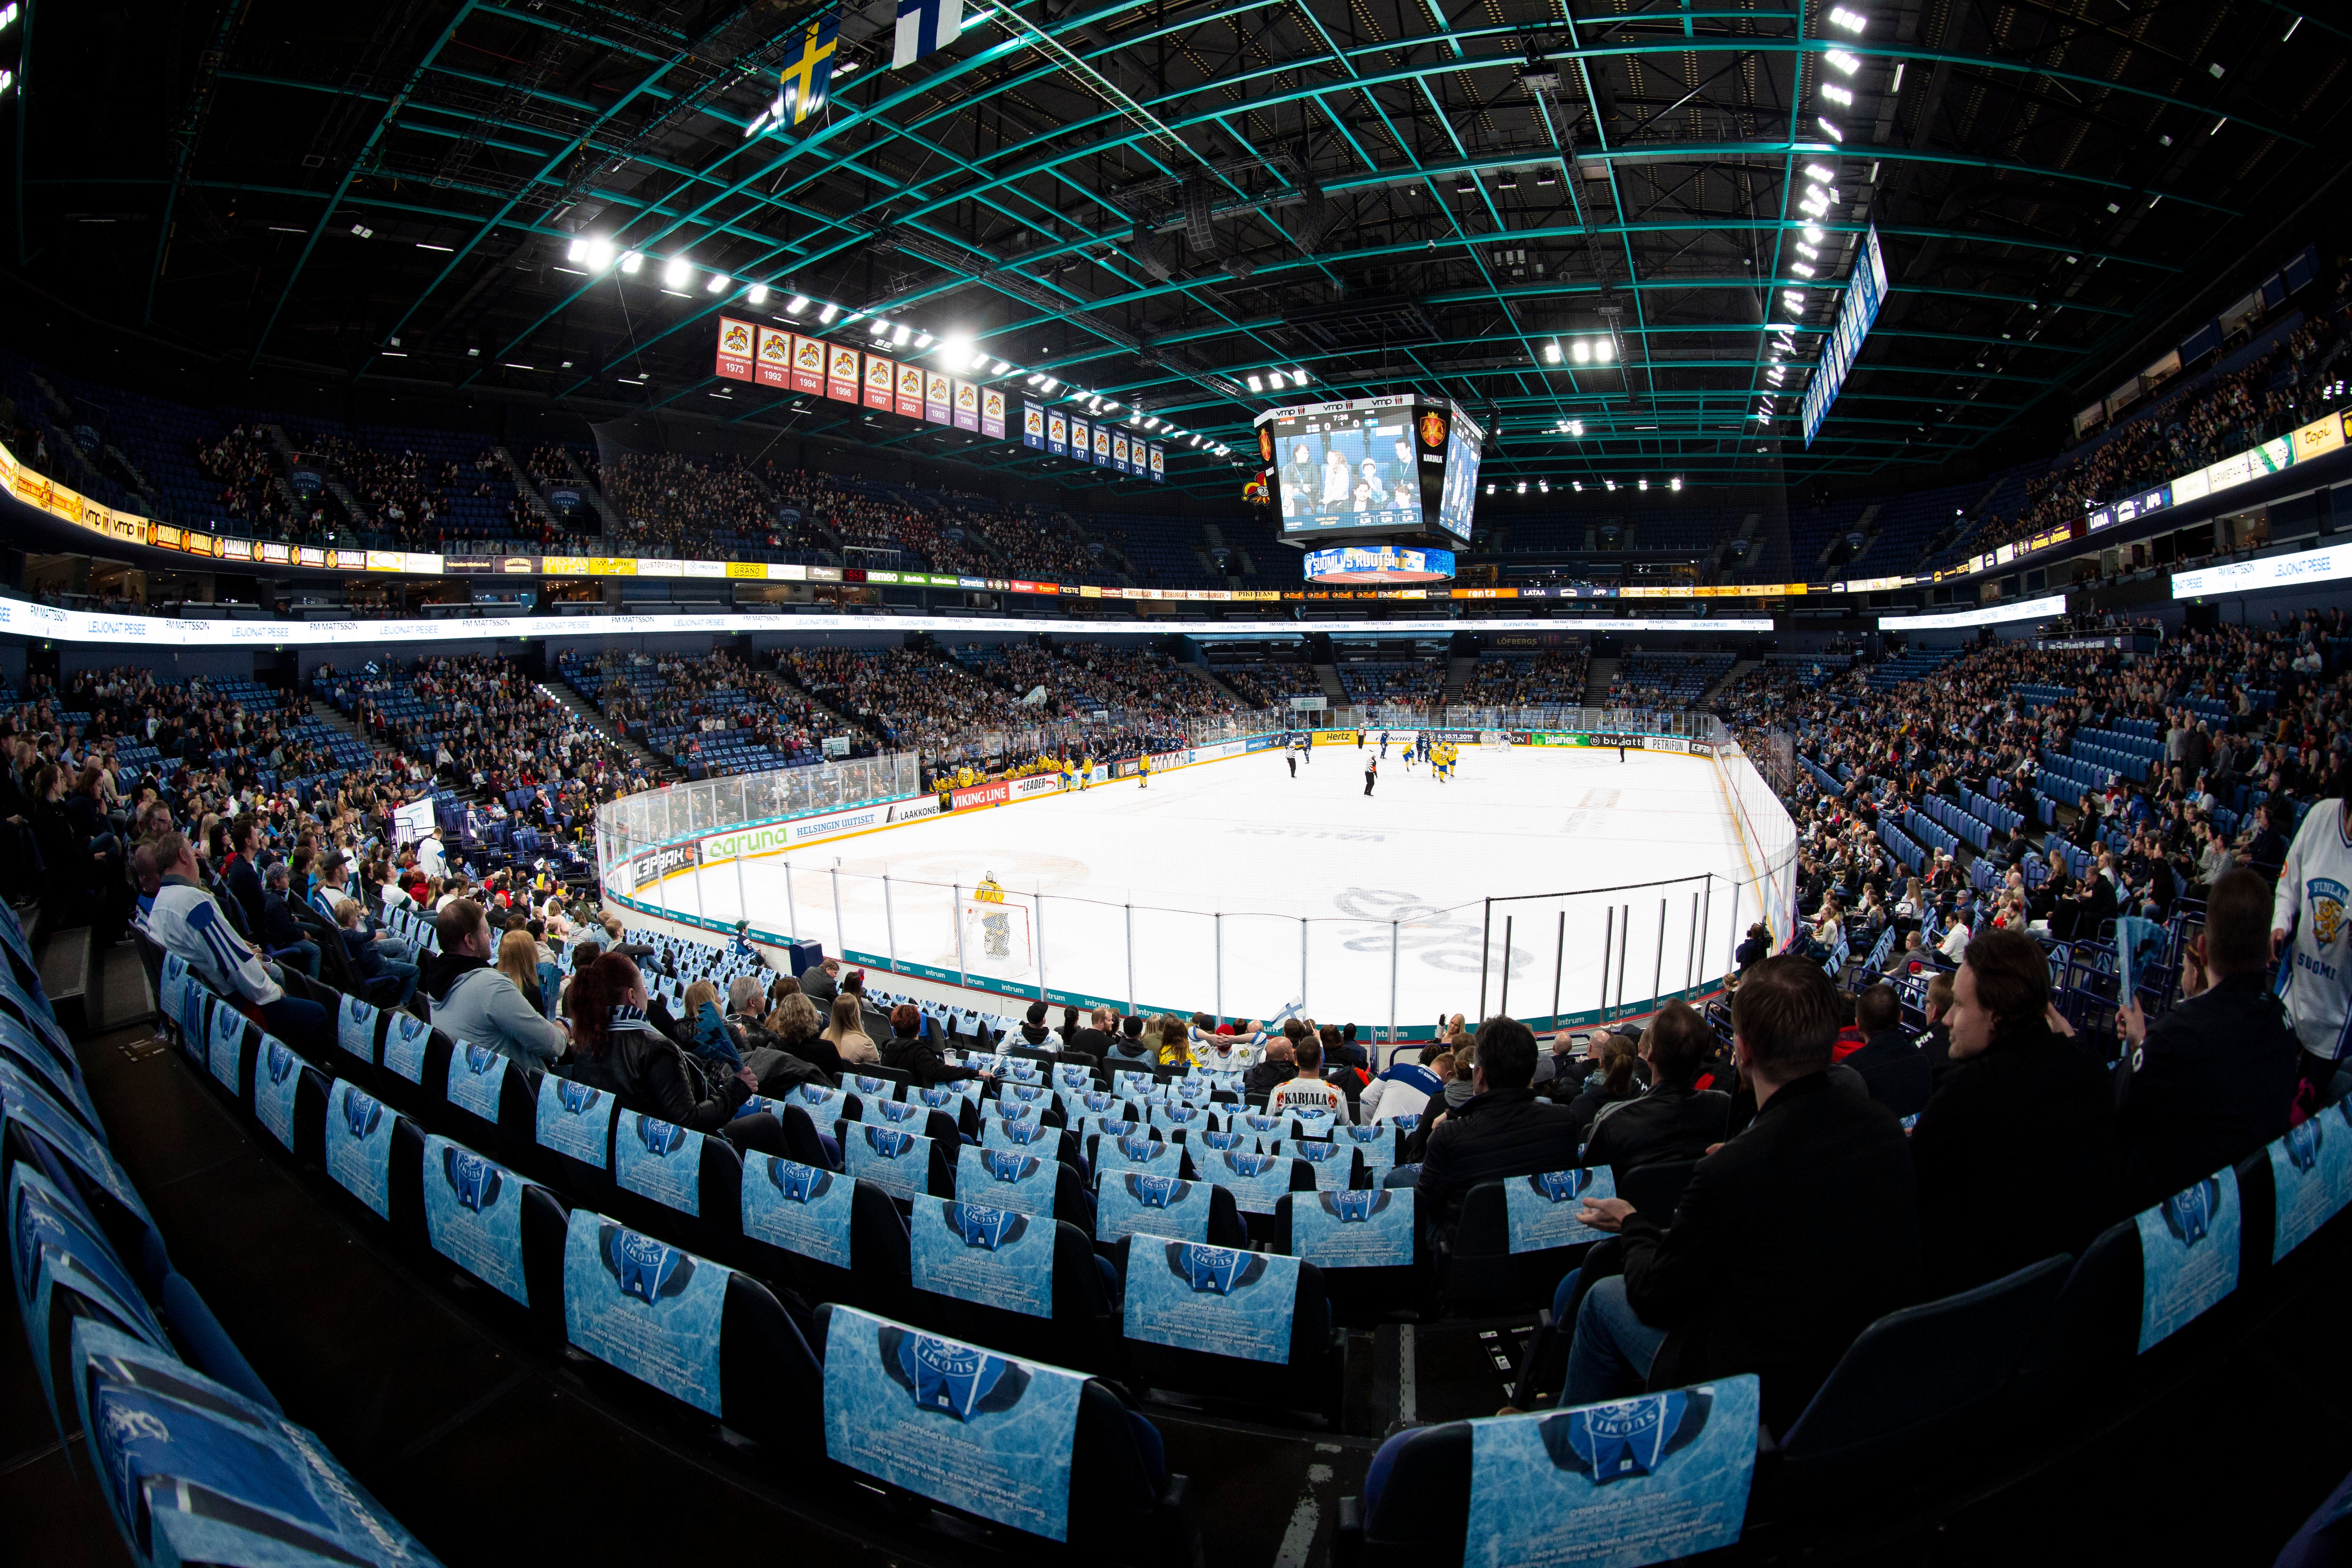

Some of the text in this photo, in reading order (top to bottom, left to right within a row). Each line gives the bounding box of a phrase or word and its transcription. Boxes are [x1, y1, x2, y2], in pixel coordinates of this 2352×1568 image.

[726, 363, 744, 374] 1973
[764, 371, 782, 381] 1992
[800, 378, 816, 388] 1994
[835, 386, 851, 396] 1996
[871, 395, 886, 405] 1997
[902, 403, 916, 412] 2002
[1025, 401, 1043, 411] TIKKANEN
[932, 410, 945, 419] 1995
[960, 416, 972, 425] 1996
[1072, 416, 1087, 425] TURUNEN
[1353, 419, 1359, 428] 0
[987, 424, 999, 432] 2003
[1324, 423, 1330, 431] 0
[2305, 423, 2331, 446] topi
[1032, 437, 1036, 445] 5
[1054, 443, 1062, 452] 15
[1077, 450, 1085, 458] 17
[1423, 454, 1442, 463] KARJALA
[1098, 456, 1106, 464] 17
[1118, 461, 1125, 470] 23
[2209, 464, 2242, 485] VARMISTAA
[85, 507, 100, 527] vmp
[2089, 512, 2109, 529] LATAA
[113, 520, 134, 537] vmp
[157, 525, 180, 544] KARJALA
[2050, 530, 2070, 544] LÖFBERGS
[190, 533, 212, 550] KARJALA
[2031, 538, 2049, 551] LÖFBERGS
[224, 539, 251, 555] KARJALA
[264, 543, 289, 559] KARJALA
[301, 547, 324, 562] KARJALA
[337, 550, 365, 564] KARJALA
[543, 557, 589, 566] FORSMAN
[1314, 553, 1395, 572] SUOMI VS RUOTSI
[2308, 557, 2330, 572] PESEE
[814, 567, 833, 576] topi
[960, 579, 984, 587] Caverion
[1161, 590, 1188, 599] HESBURGER
[31, 606, 67, 622] FM MATTSSON
[125, 624, 145, 635] PESEE
[166, 620, 209, 630] FM MATTSSON
[416, 626, 438, 634] PESEE
[268, 628, 289, 637] PESEE
[1327, 733, 1349, 741] Hertz
[1545, 735, 1577, 745] planex
[1604, 737, 1644, 747] buatti
[1653, 738, 1683, 751] PETRIFUN
[1023, 778, 1045, 791] LEADER
[953, 787, 1006, 808] VIKING LINE
[797, 814, 874, 835] HELSINGIN UUTISET
[709, 827, 786, 856] caruna
[858, 956, 876, 964] intrum
[2297, 952, 2336, 980] SUOMI
[925, 969, 945, 978] intrum
[1002, 984, 1024, 994] intrum
[1085, 998, 1110, 1009] intrum
[1558, 1016, 1584, 1026] intrum
[1423, 1071, 1437, 1083] KARJALA
[1284, 1092, 1327, 1105] KARJALA
[970, 1212, 998, 1224] SUOMI
[626, 1243, 659, 1263] SUOMI
[1196, 1254, 1231, 1265] SUOMI
[922, 1350, 974, 1372] SUOMI
[1596, 1412, 1656, 1434] SUOMI
